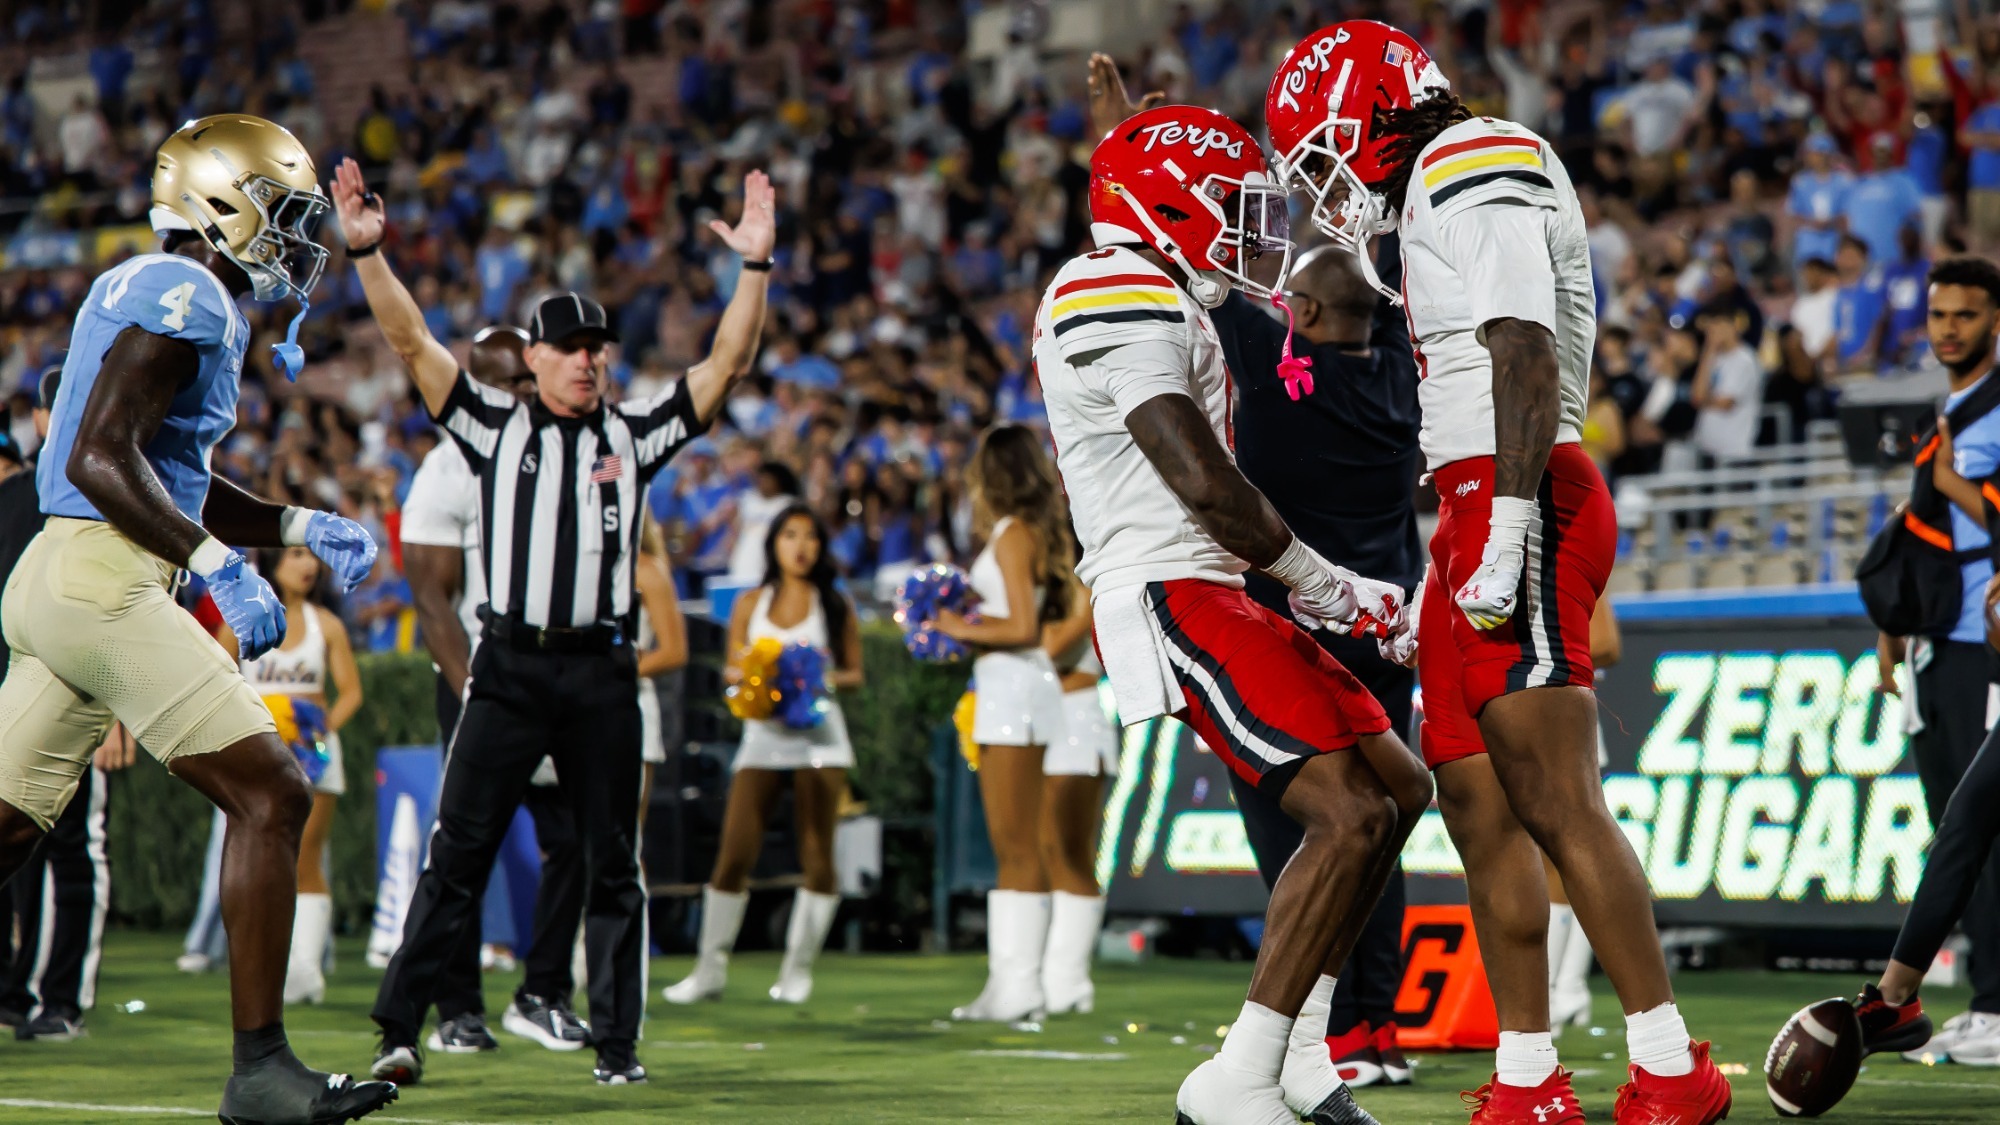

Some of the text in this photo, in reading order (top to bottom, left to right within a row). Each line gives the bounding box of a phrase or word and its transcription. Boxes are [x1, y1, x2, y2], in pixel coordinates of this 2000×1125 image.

[1277, 27, 1351, 112] Terps
[1141, 120, 1244, 159] Terps
[158, 281, 197, 332] 4
[521, 453, 538, 474] S
[603, 504, 619, 532] S
[1637, 650, 1911, 777] ZERO
[1600, 773, 1933, 903] SUGAR
[1395, 924, 1464, 1028] G
